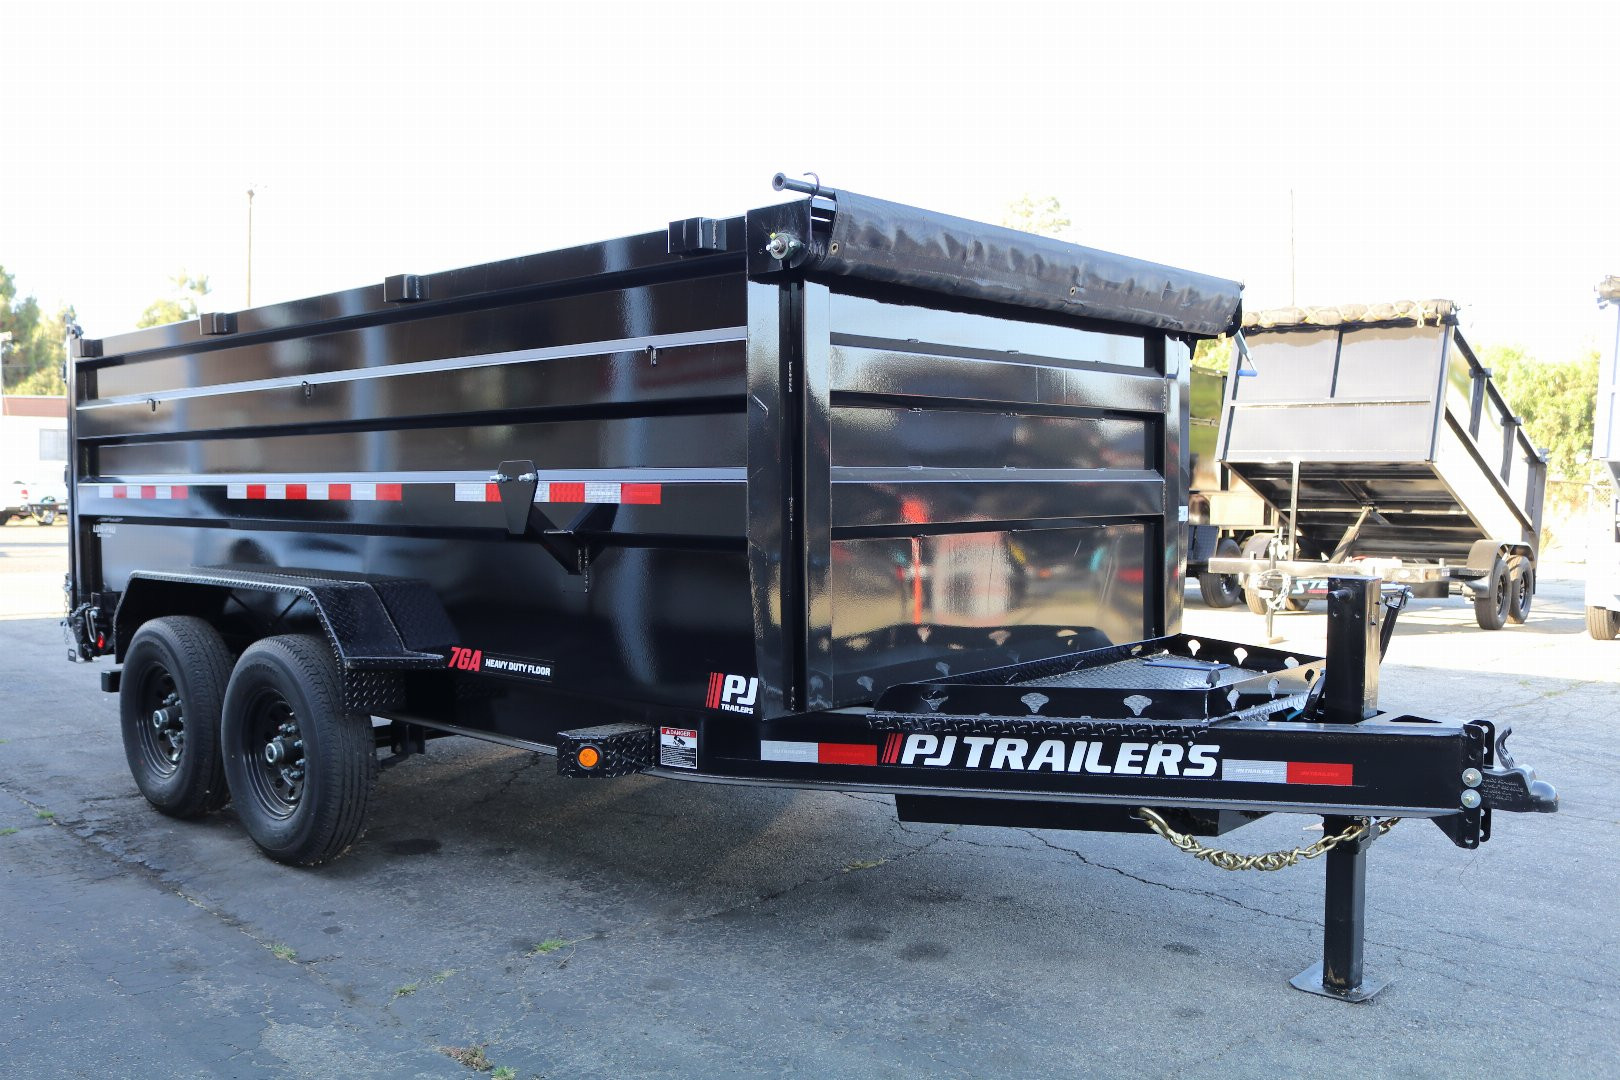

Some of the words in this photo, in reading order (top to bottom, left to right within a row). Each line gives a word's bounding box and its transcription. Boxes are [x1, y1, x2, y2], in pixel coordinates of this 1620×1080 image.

[448, 646, 482, 672] 7GA
[485, 658, 508, 670] HEAVY
[508, 662, 527, 673] DUTY
[527, 665, 551, 677] FLOOR
[721, 674, 759, 705] PJ
[721, 703, 754, 715] TRAILERS
[670, 729, 691, 737] DANGER
[900, 734, 957, 766] PJ
[963, 736, 1221, 777] TRAILERS
